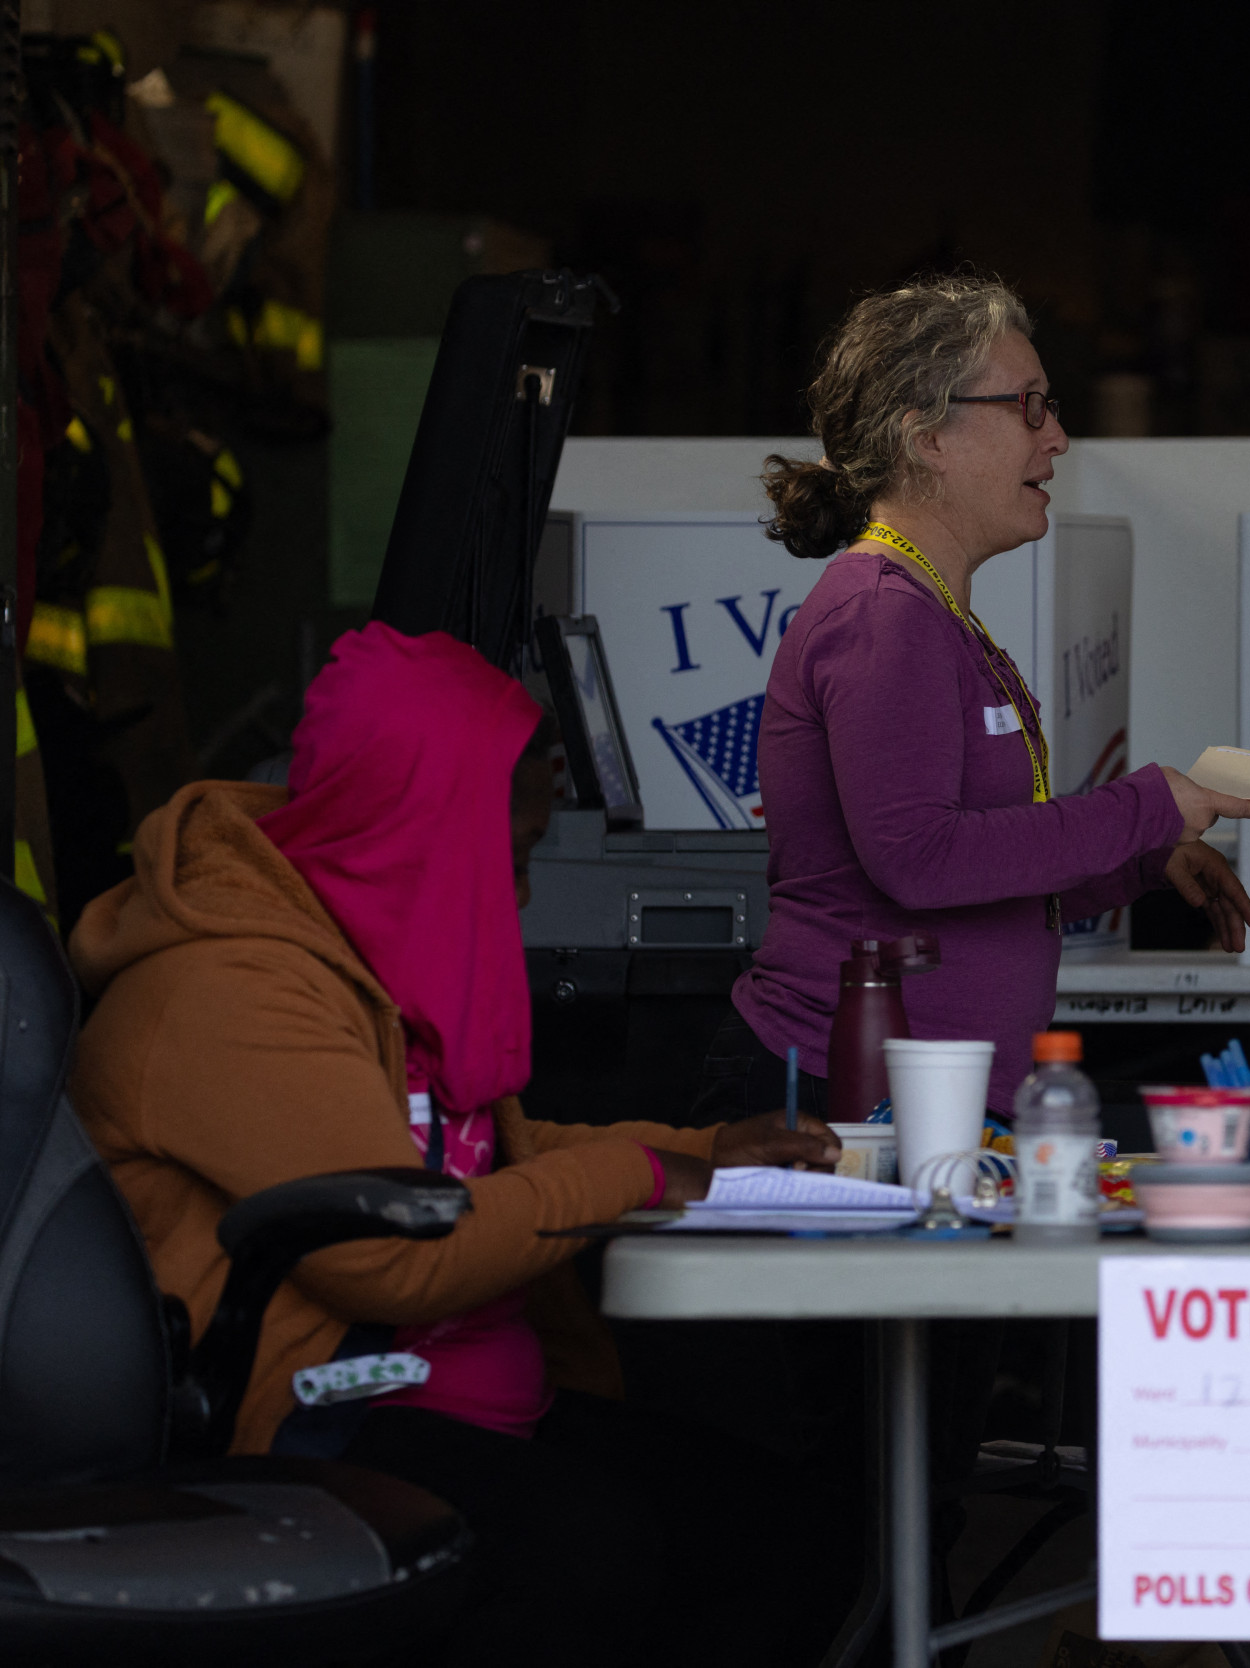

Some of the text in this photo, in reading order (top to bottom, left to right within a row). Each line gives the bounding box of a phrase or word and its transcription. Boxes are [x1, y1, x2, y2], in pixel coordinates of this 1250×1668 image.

[915, 554, 954, 605] Division
[660, 602, 701, 673] I
[1201, 1372, 1244, 1408] 12
[1134, 1574, 1235, 1607] POLLS
